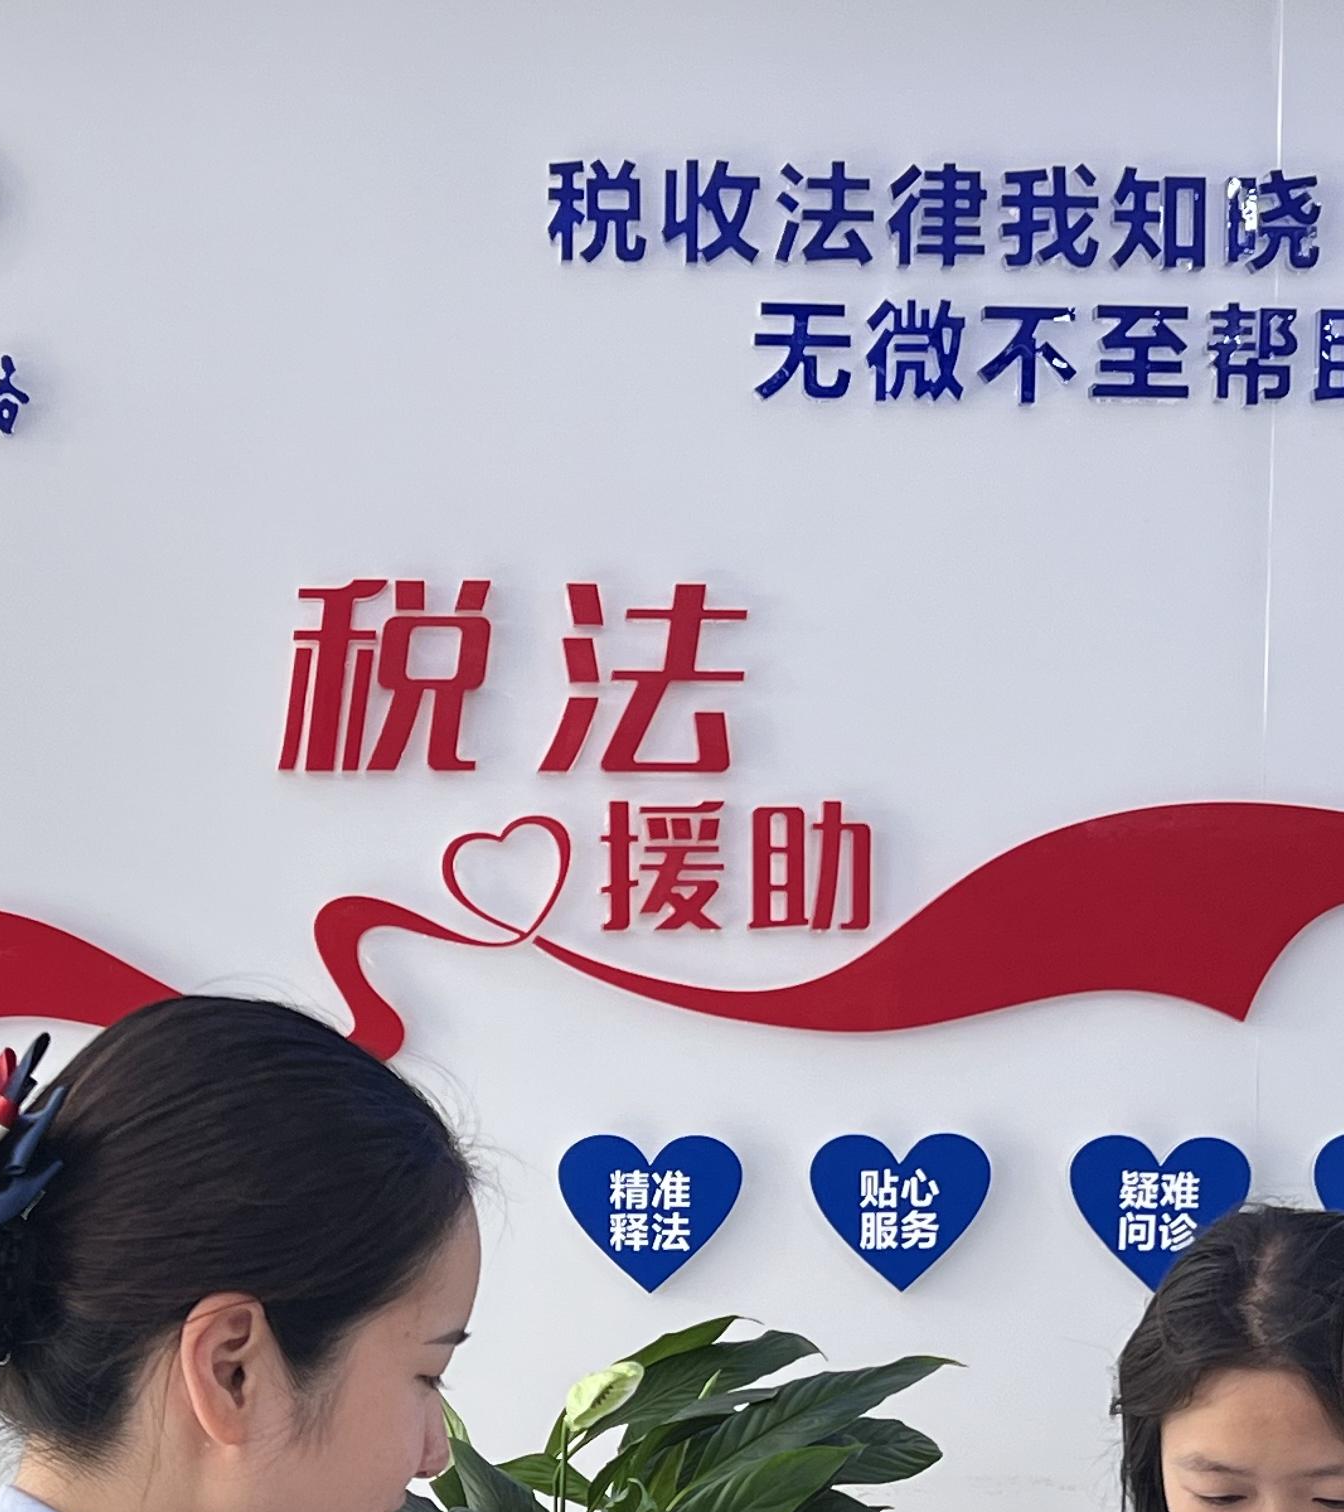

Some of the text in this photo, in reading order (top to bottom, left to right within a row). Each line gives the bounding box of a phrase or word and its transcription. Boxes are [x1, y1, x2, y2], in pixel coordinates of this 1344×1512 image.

[547, 160, 1323, 273] 税收法律我知晓
[278, 579, 749, 773] 税法
[601, 801, 871, 932] 援助
[610, 1170, 690, 1210] 精准
[860, 1169, 939, 1209] 贴心
[1119, 1170, 1200, 1211] 疑难
[610, 1212, 690, 1251] 释法
[859, 1210, 940, 1250] 服务
[1118, 1213, 1197, 1252] 问诊
